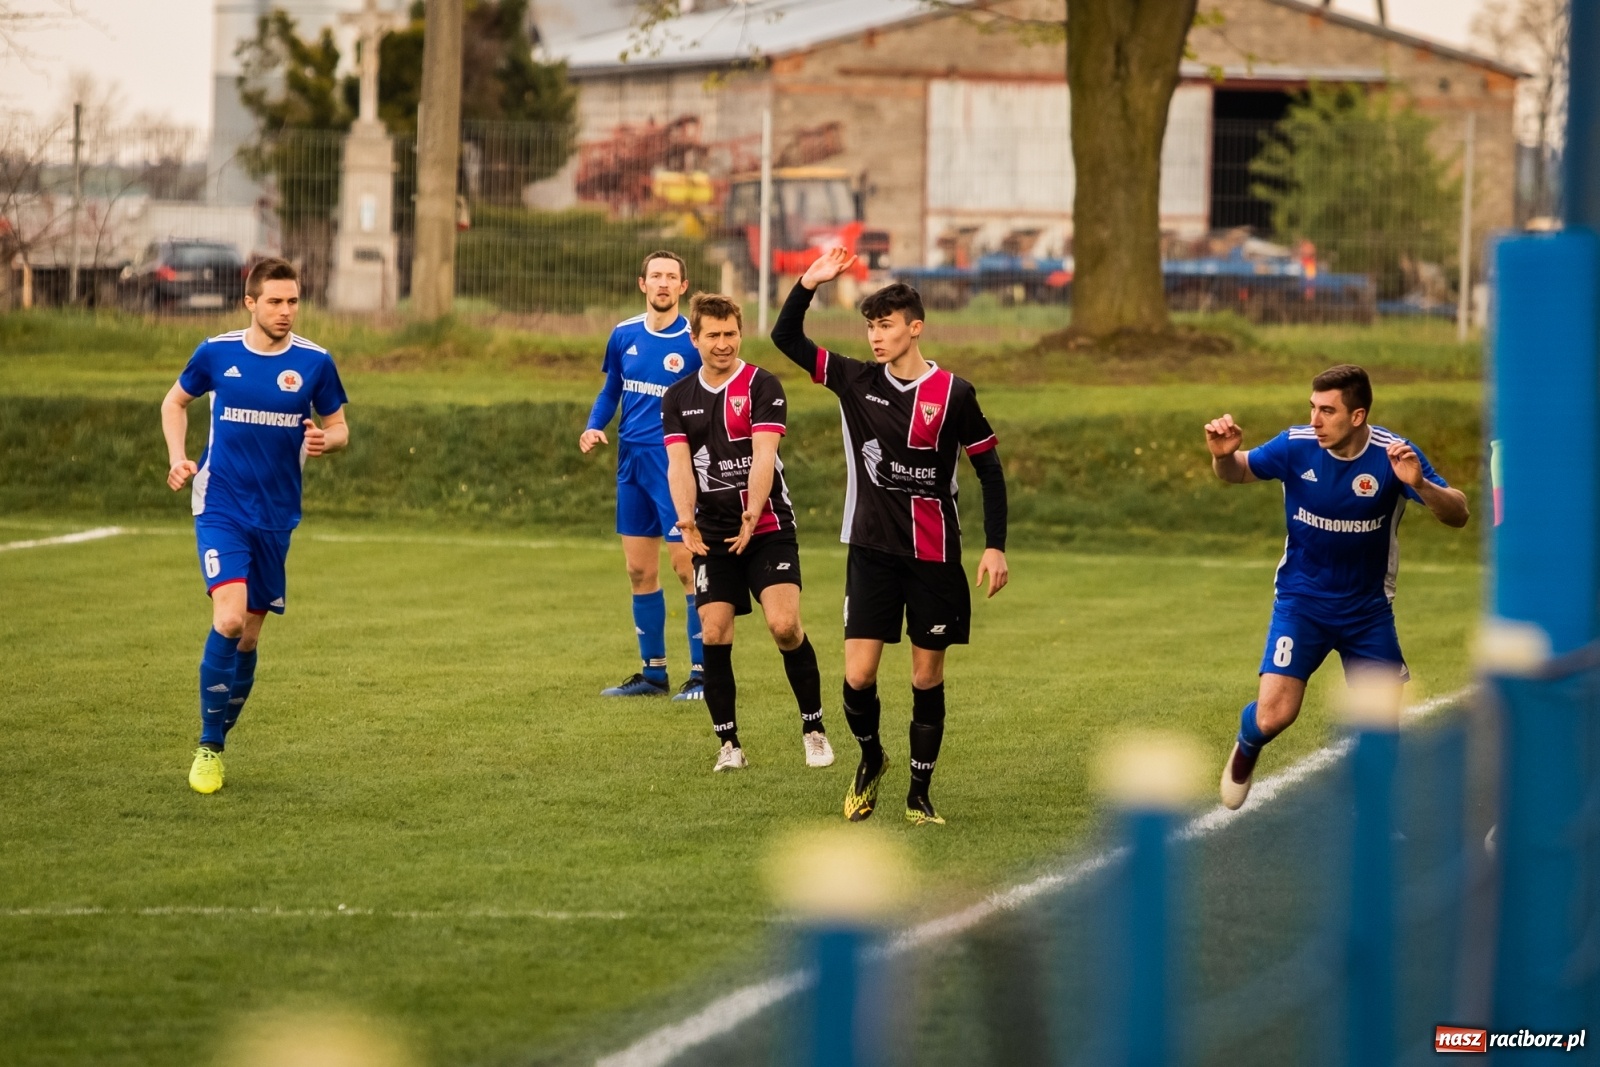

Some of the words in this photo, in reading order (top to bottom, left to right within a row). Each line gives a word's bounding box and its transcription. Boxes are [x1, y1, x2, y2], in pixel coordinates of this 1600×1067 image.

[718, 456, 753, 471] 100-LEC
[204, 548, 221, 579] 6
[1273, 636, 1294, 668] 8
